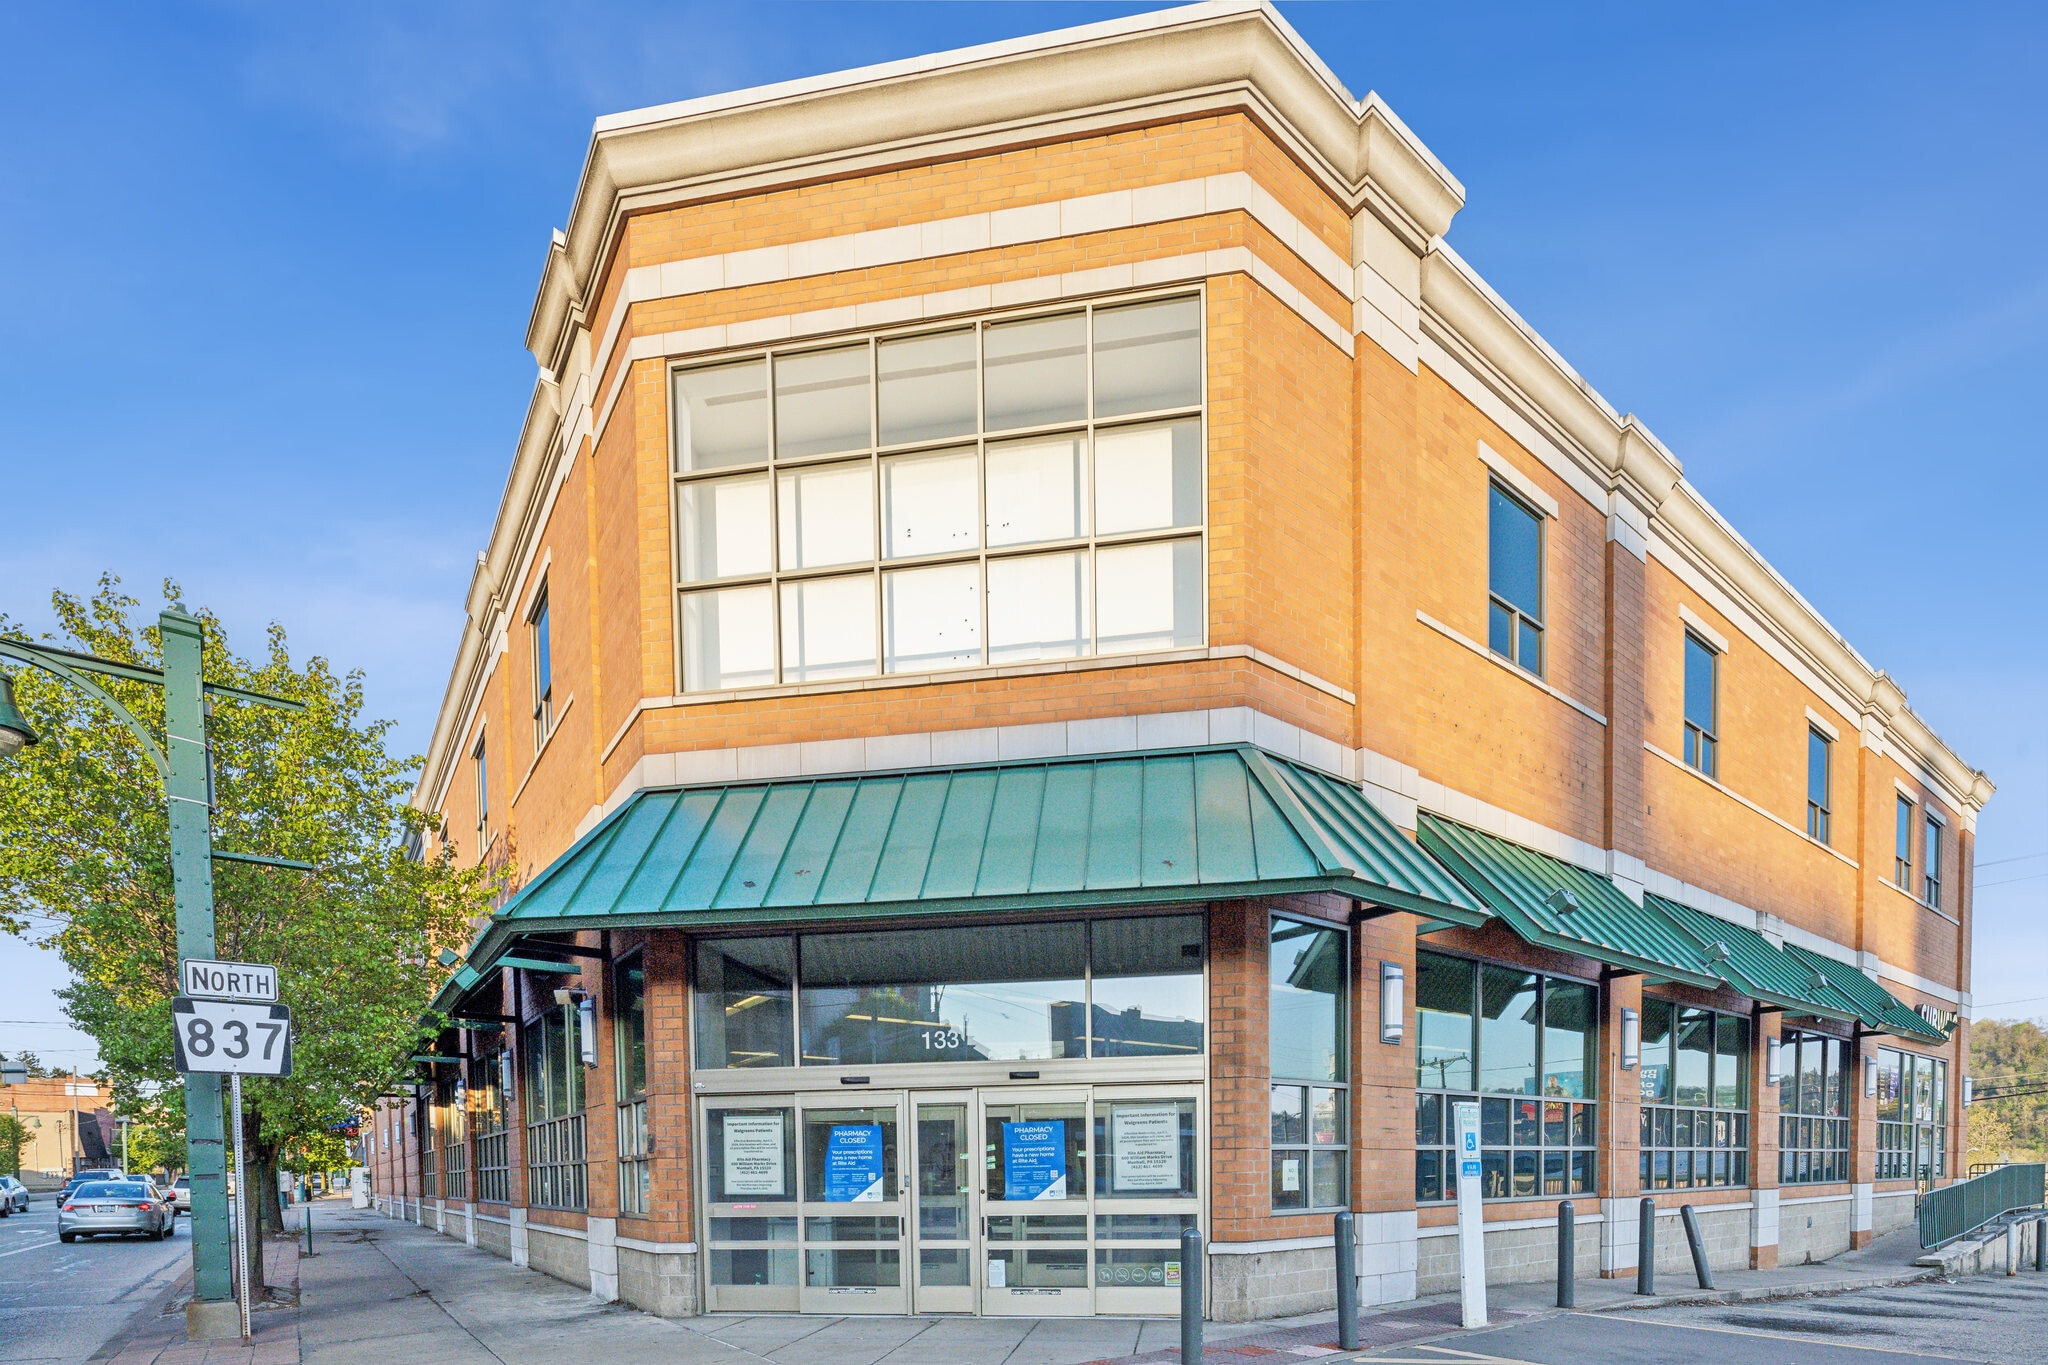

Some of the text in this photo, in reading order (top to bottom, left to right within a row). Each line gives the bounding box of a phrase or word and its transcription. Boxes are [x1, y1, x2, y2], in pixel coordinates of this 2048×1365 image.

[192, 966, 270, 995] NORTH
[187, 1018, 282, 1061] 837
[921, 1030, 960, 1050] 133
